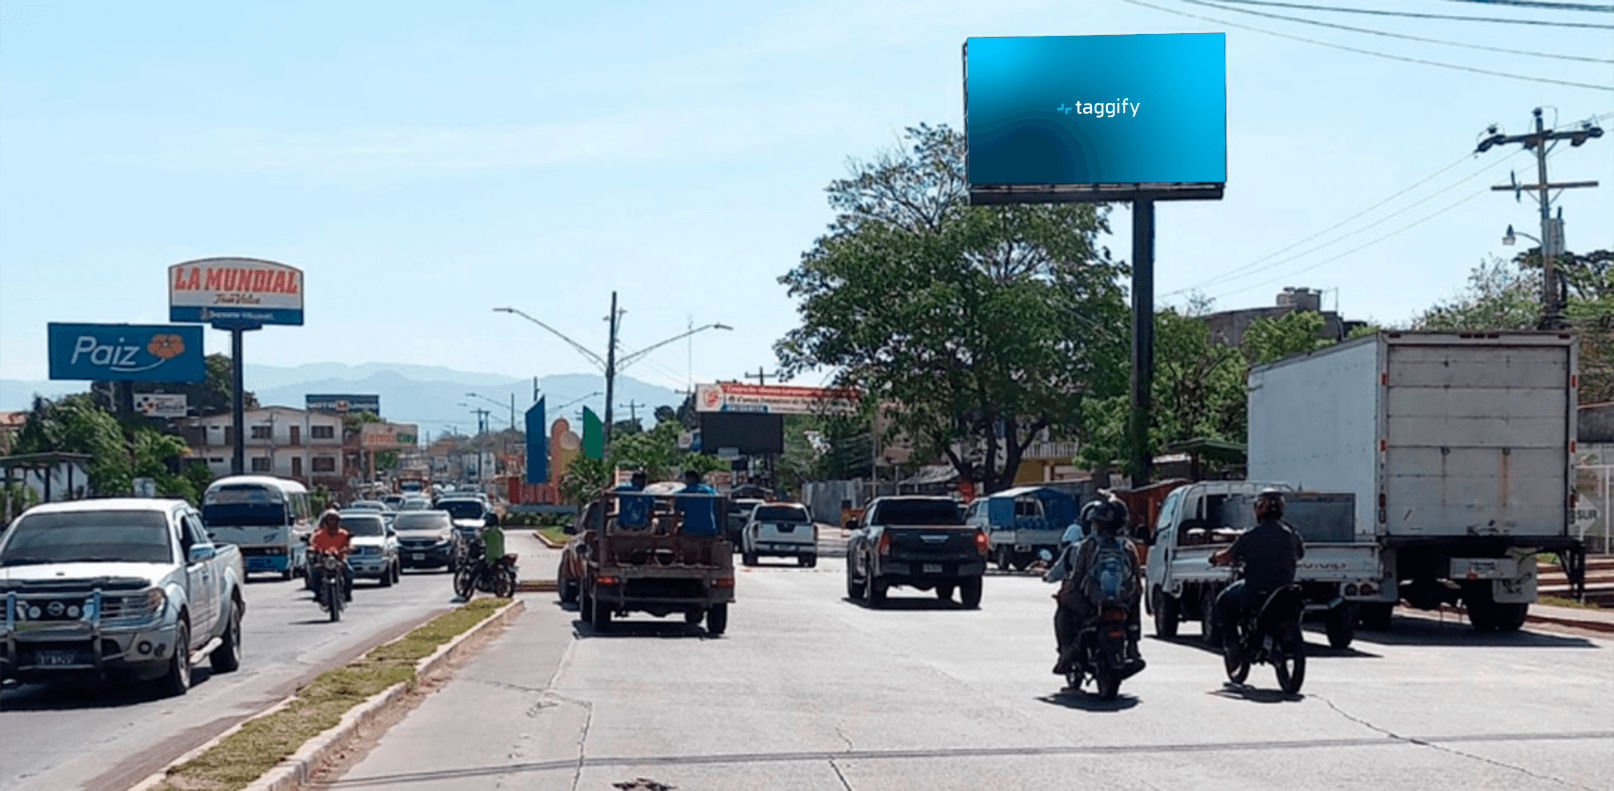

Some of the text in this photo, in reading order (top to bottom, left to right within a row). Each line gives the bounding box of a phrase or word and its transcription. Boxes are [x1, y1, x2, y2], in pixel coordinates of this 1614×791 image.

[1075, 98, 1140, 118] taggify
[174, 267, 297, 294] LA MUNDIAL
[71, 336, 140, 365] Paiz
